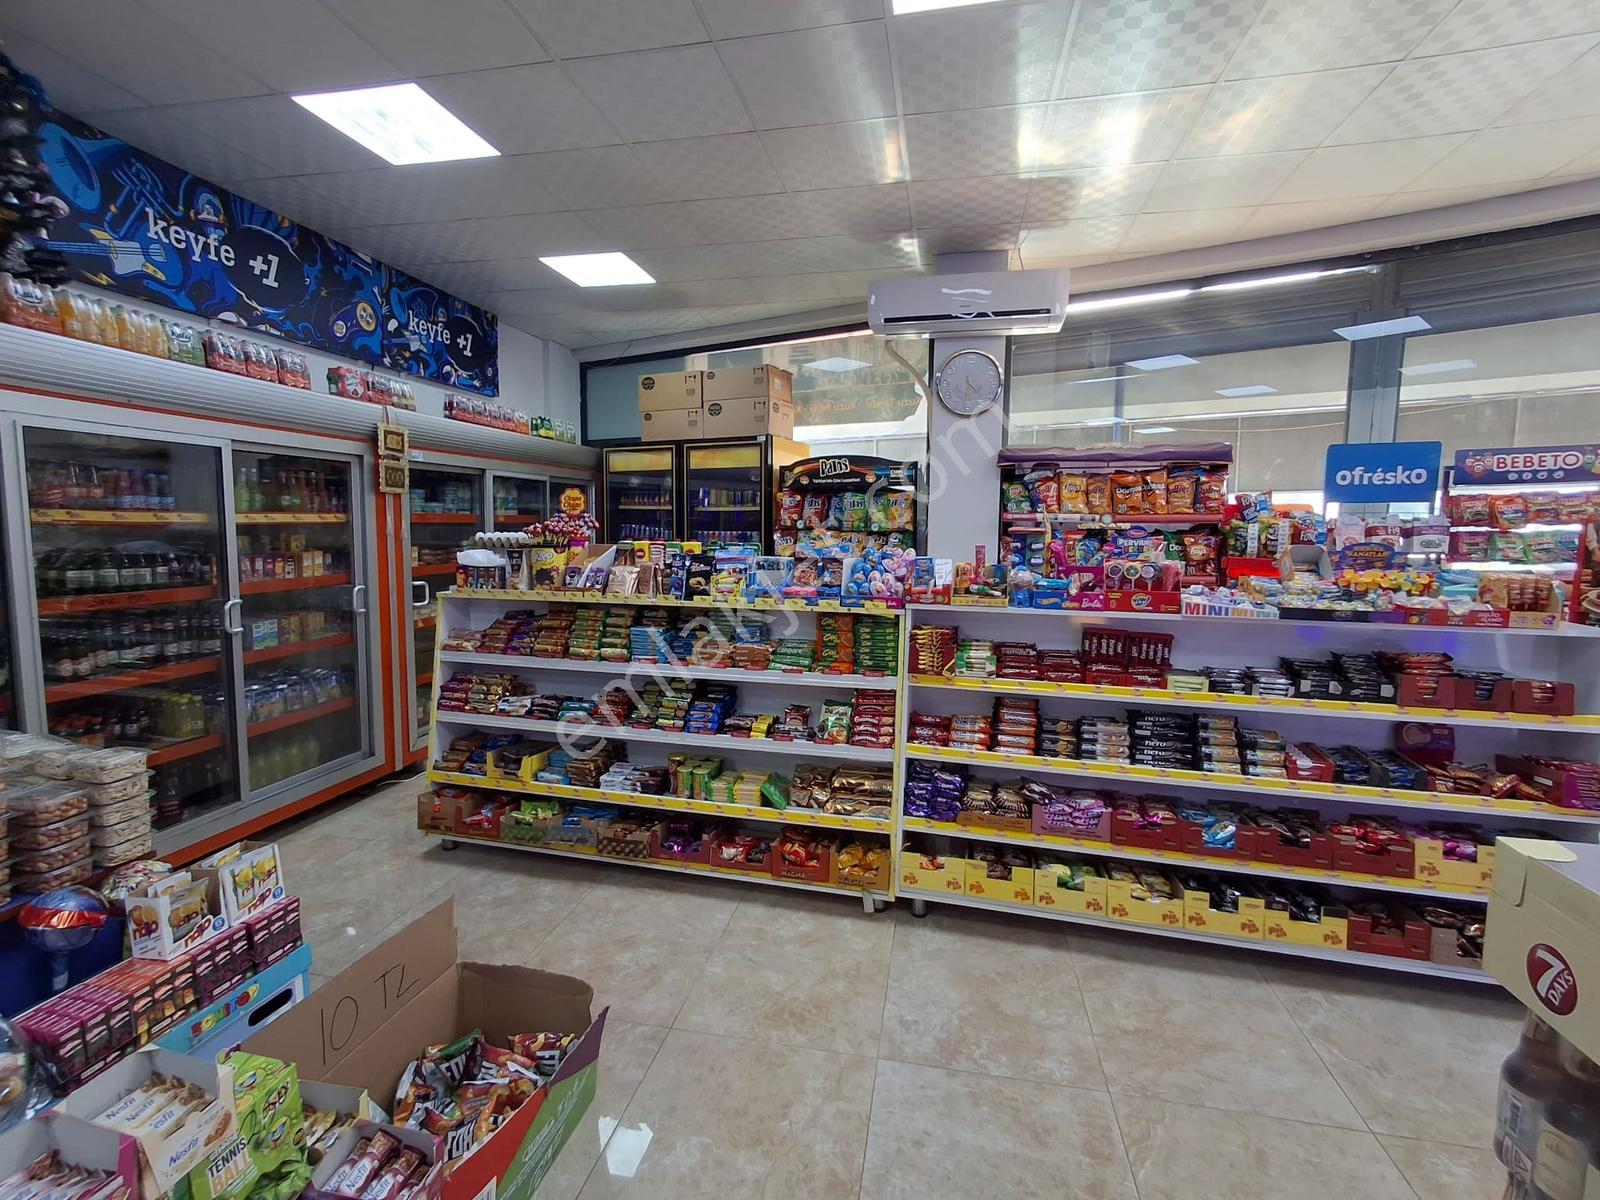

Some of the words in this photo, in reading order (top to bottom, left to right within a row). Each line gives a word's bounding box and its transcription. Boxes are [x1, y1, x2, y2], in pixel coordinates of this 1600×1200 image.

[145, 207, 236, 268] keyfe
[248, 252, 281, 290] +1
[407, 310, 452, 346] keyfe
[456, 330, 474, 358] +1
[1496, 452, 1581, 470] BEBETO
[1536, 948, 1566, 998] 7
[1546, 968, 1575, 1007] DAYS
[321, 995, 359, 1067] 10
[168, 1136, 201, 1168] Nesfit
[207, 1137, 248, 1178] TENNIS
[345, 1163, 369, 1192] Nesfit
